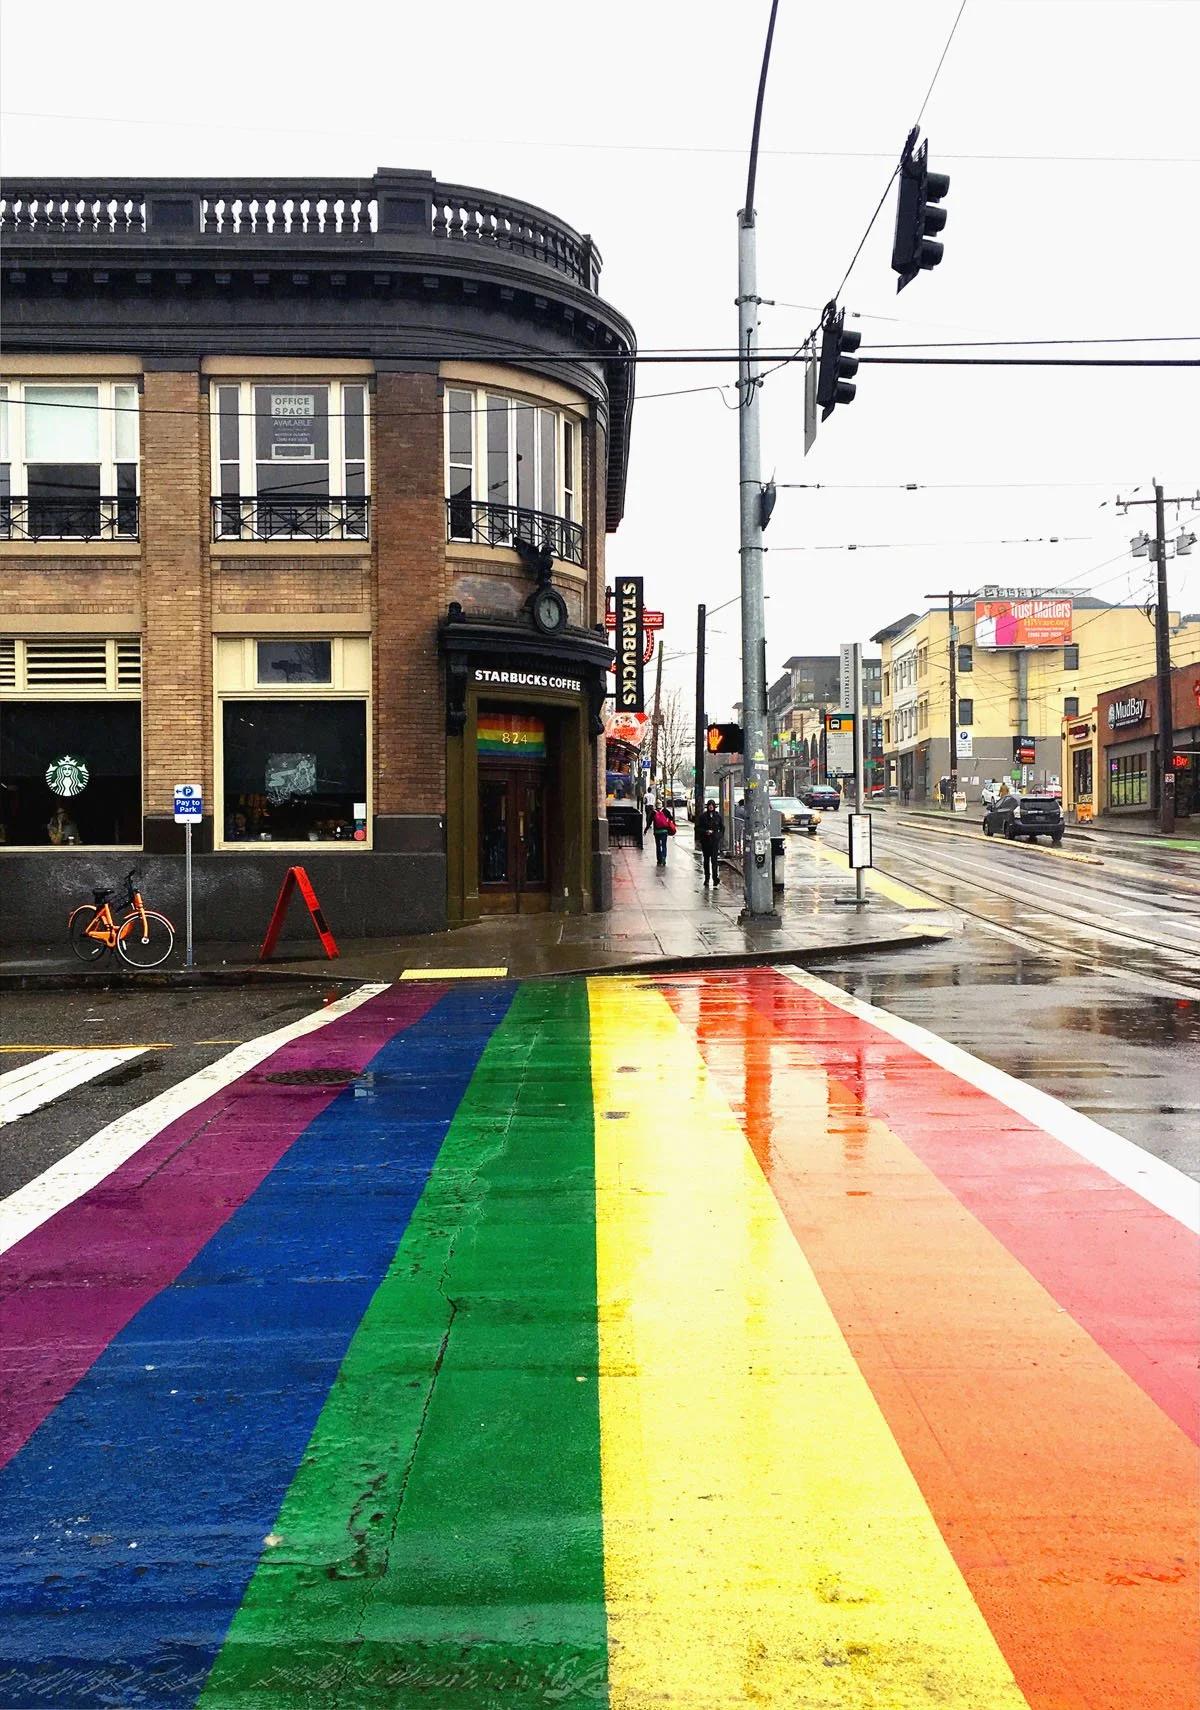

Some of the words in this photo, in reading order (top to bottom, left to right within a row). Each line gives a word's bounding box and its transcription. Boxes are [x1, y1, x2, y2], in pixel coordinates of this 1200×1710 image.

[274, 397, 310, 405] OFFICE
[274, 407, 310, 415] SPACE
[1010, 602, 1033, 618] Trust
[1034, 601, 1070, 618] Matters
[622, 582, 637, 704] STARBUCKS
[475, 669, 548, 687] STARBUCKS
[549, 676, 581, 691] COFFEE
[502, 732, 528, 745] 824
[176, 799, 190, 807] Pay
